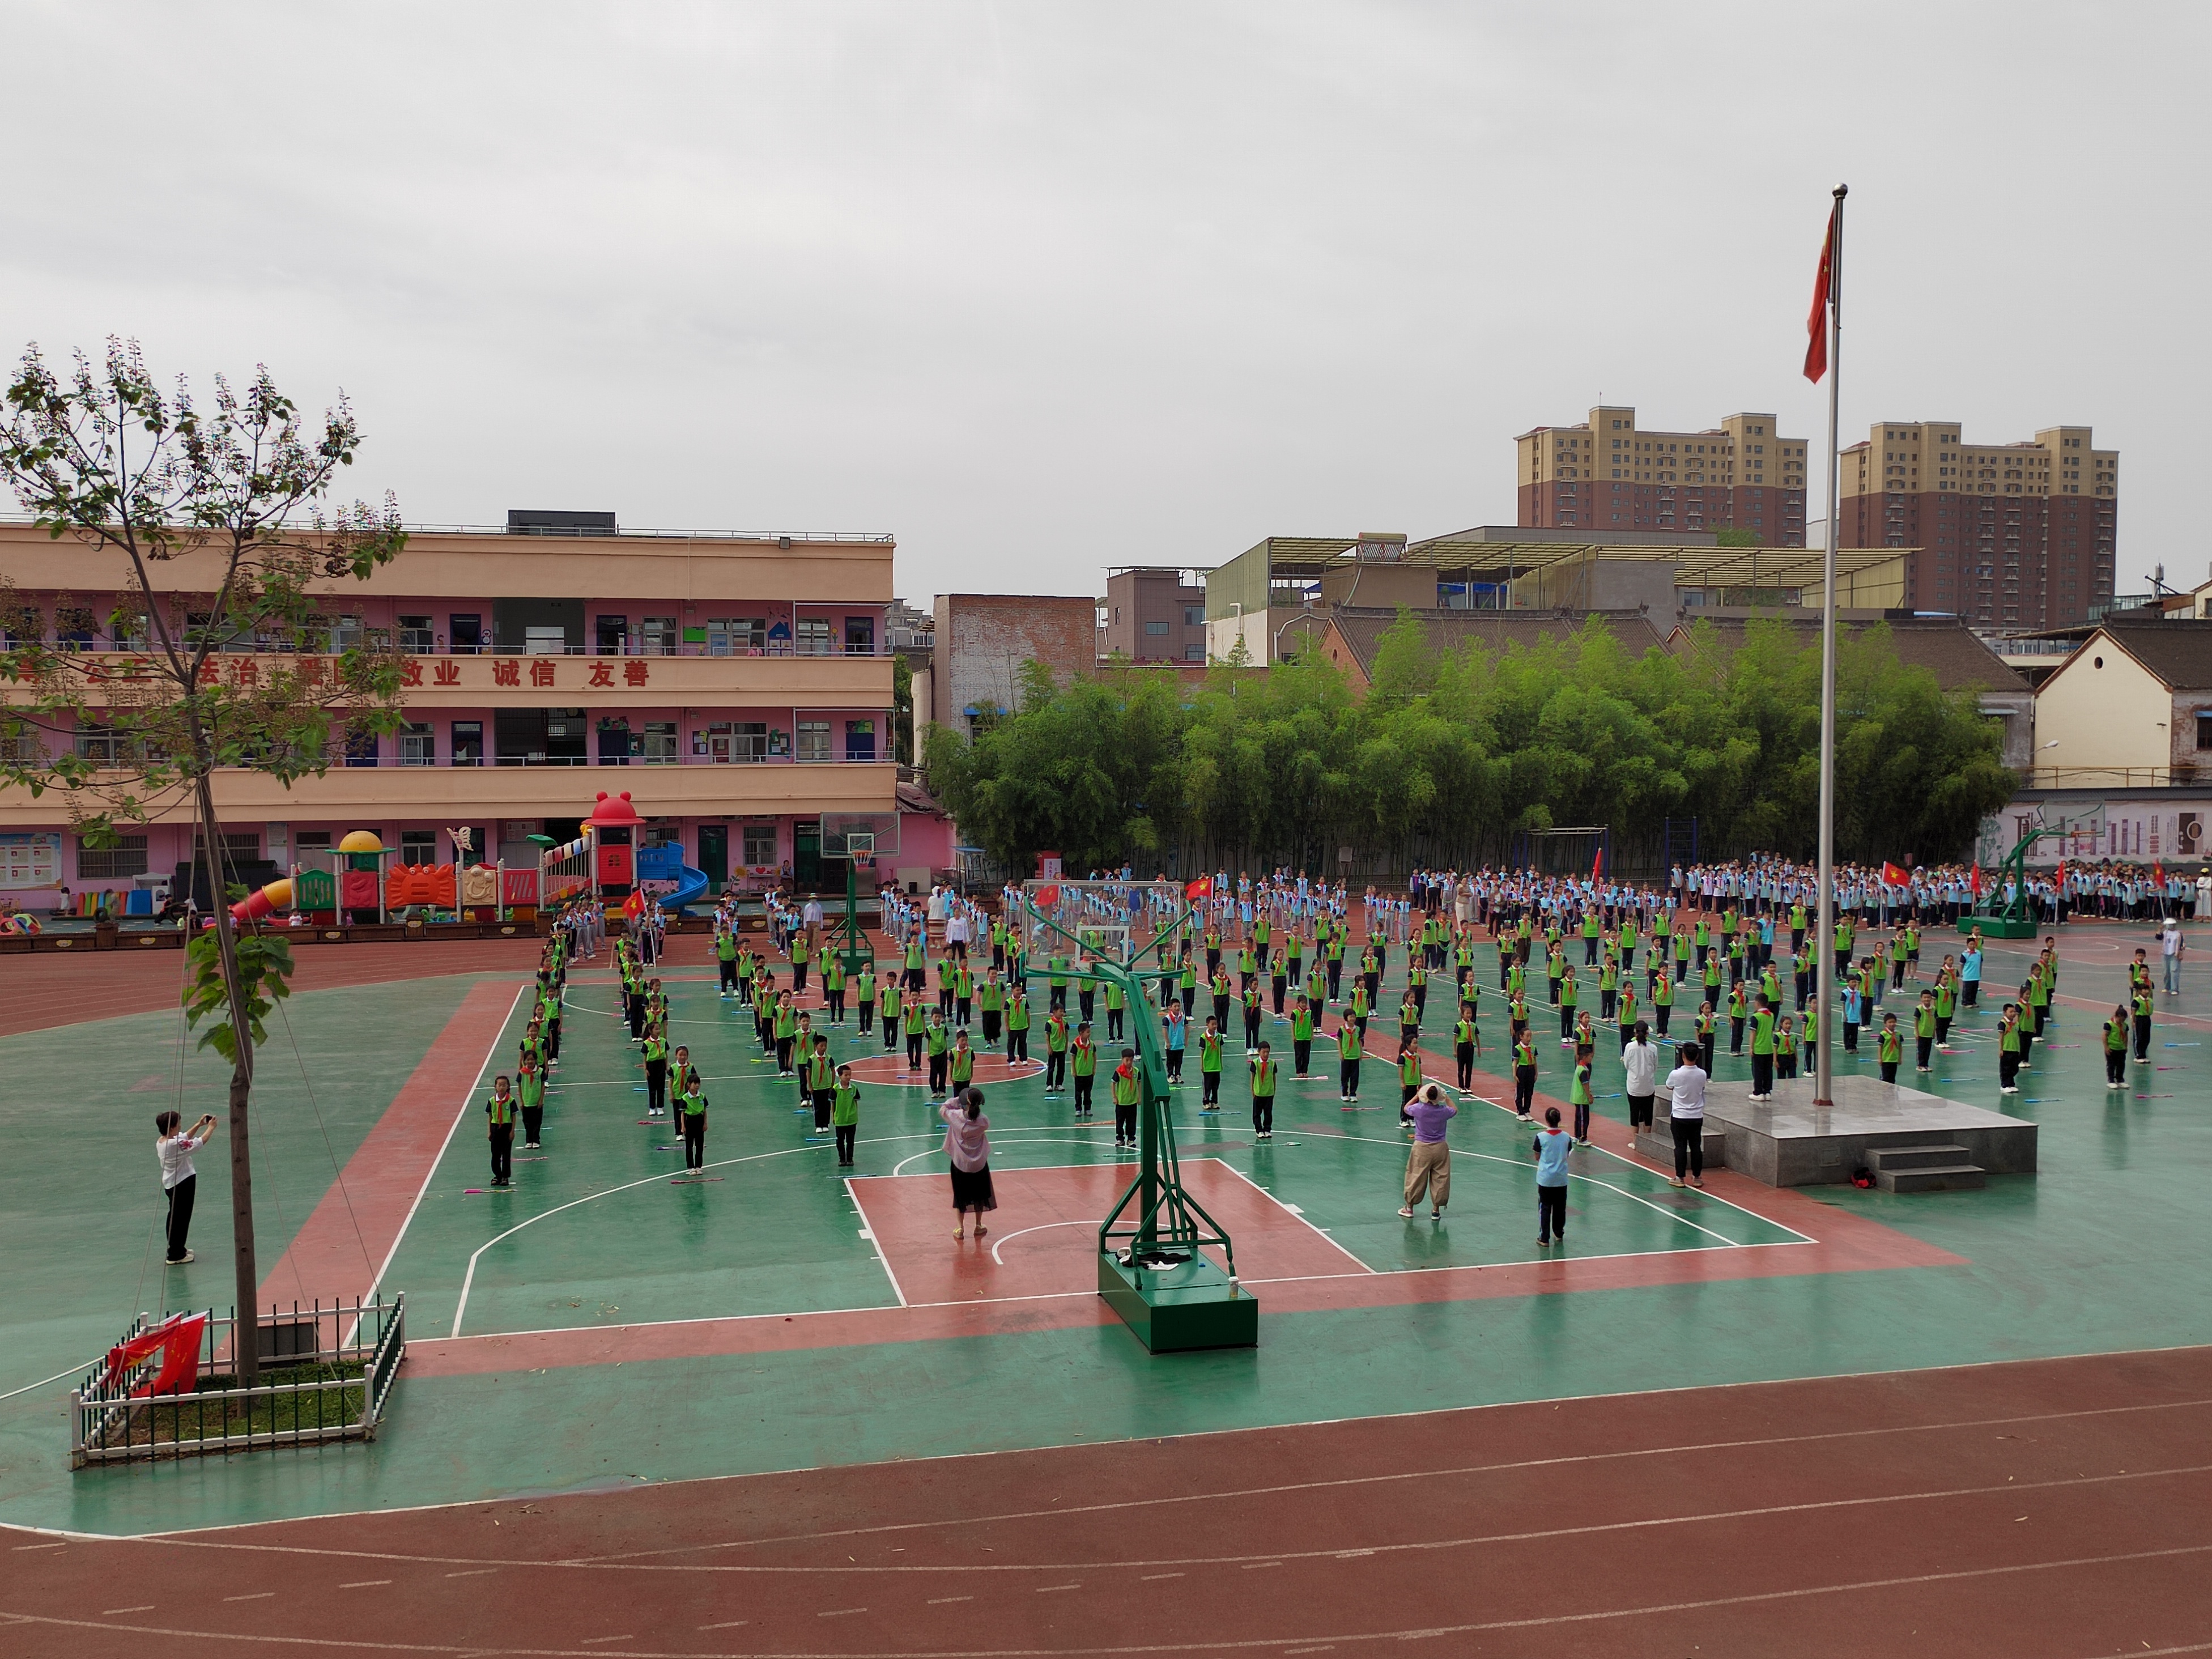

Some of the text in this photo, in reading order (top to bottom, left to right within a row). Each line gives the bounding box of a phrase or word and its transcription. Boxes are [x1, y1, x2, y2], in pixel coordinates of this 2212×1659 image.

[83, 657, 152, 683] 公正
[492, 660, 556, 687] 诚信
[588, 660, 649, 687] 友善
